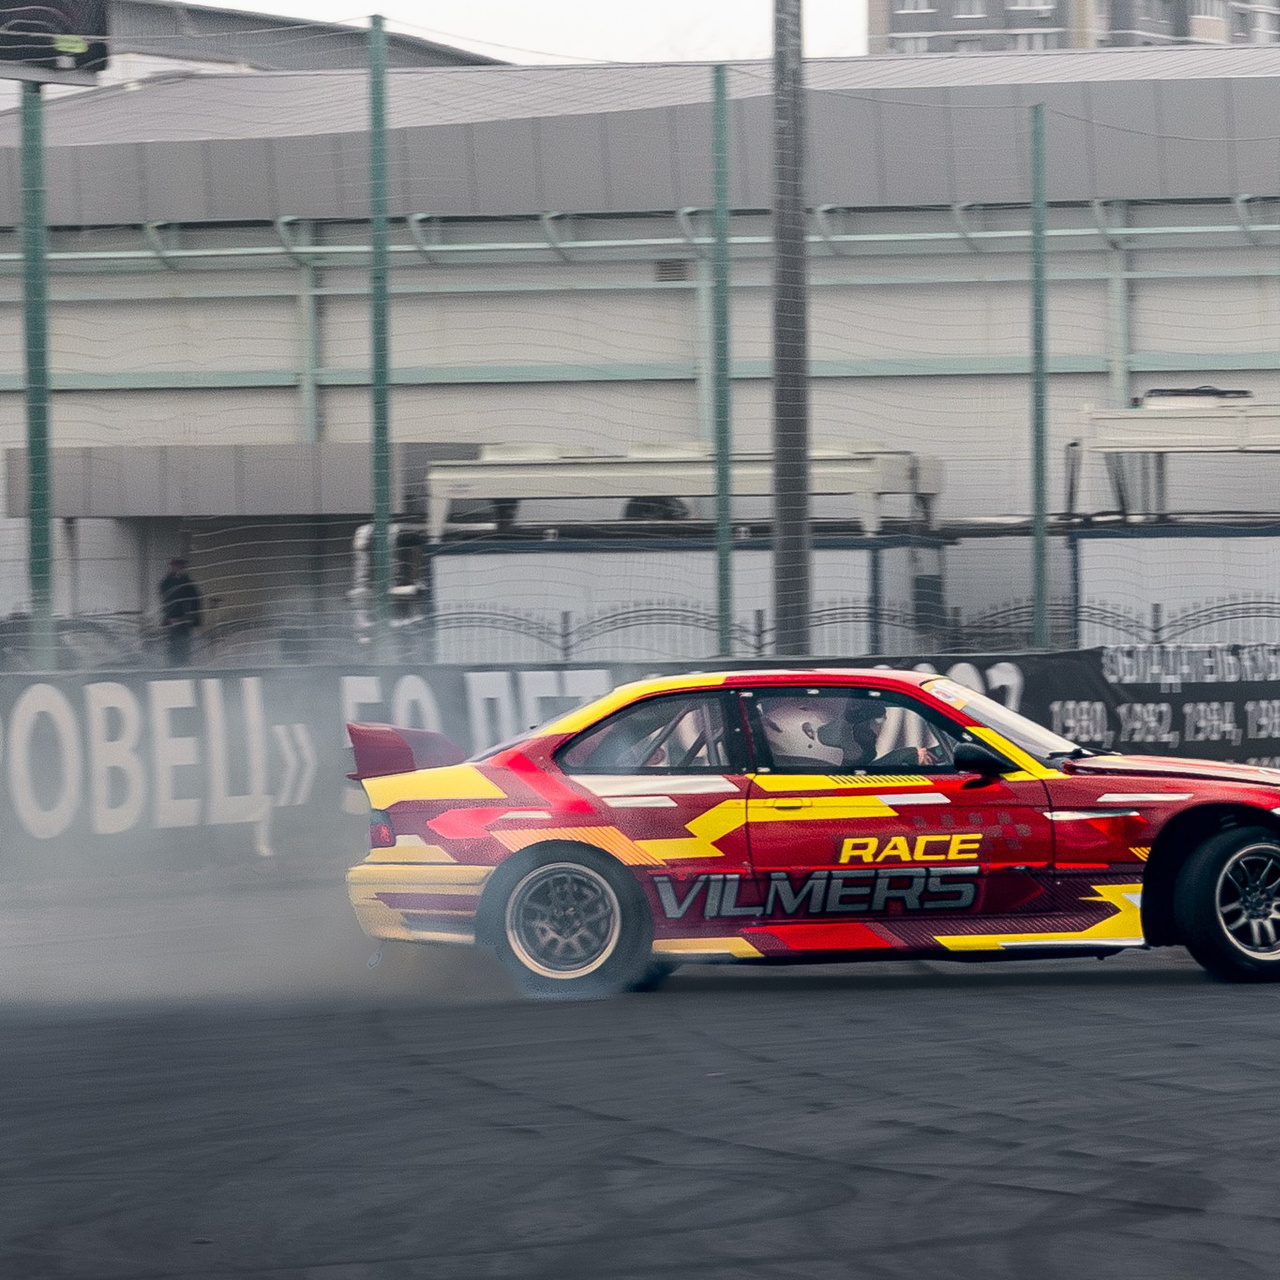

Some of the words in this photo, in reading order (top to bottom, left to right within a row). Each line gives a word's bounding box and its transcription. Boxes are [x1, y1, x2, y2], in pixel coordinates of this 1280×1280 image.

[0, 676, 318, 856] ОВЕЦ»
[838, 833, 984, 864] RACE
[652, 865, 981, 920] VILMERS
